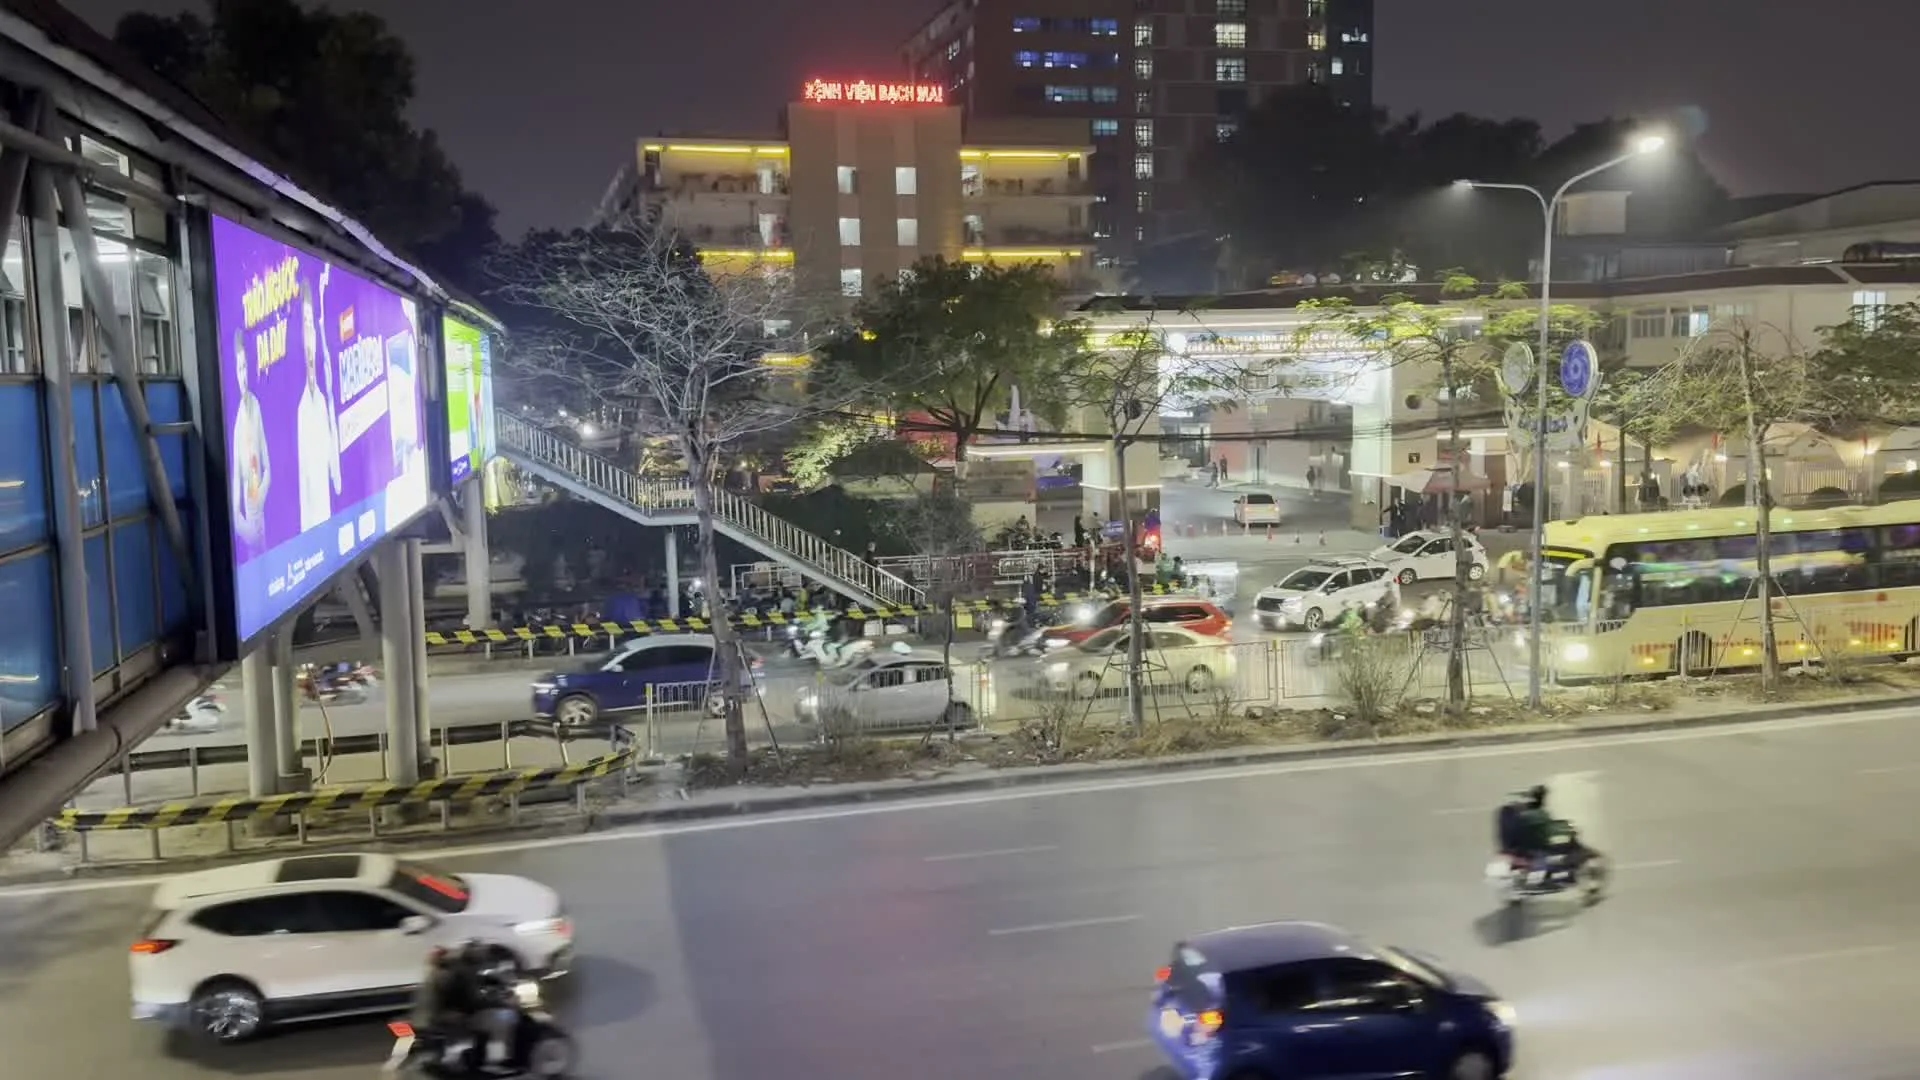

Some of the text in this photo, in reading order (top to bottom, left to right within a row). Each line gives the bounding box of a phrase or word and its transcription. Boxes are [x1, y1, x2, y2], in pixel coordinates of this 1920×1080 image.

[845, 80, 876, 103] VIỆN
[879, 84, 914, 104] BẠCH
[917, 86, 943, 102] MAI
